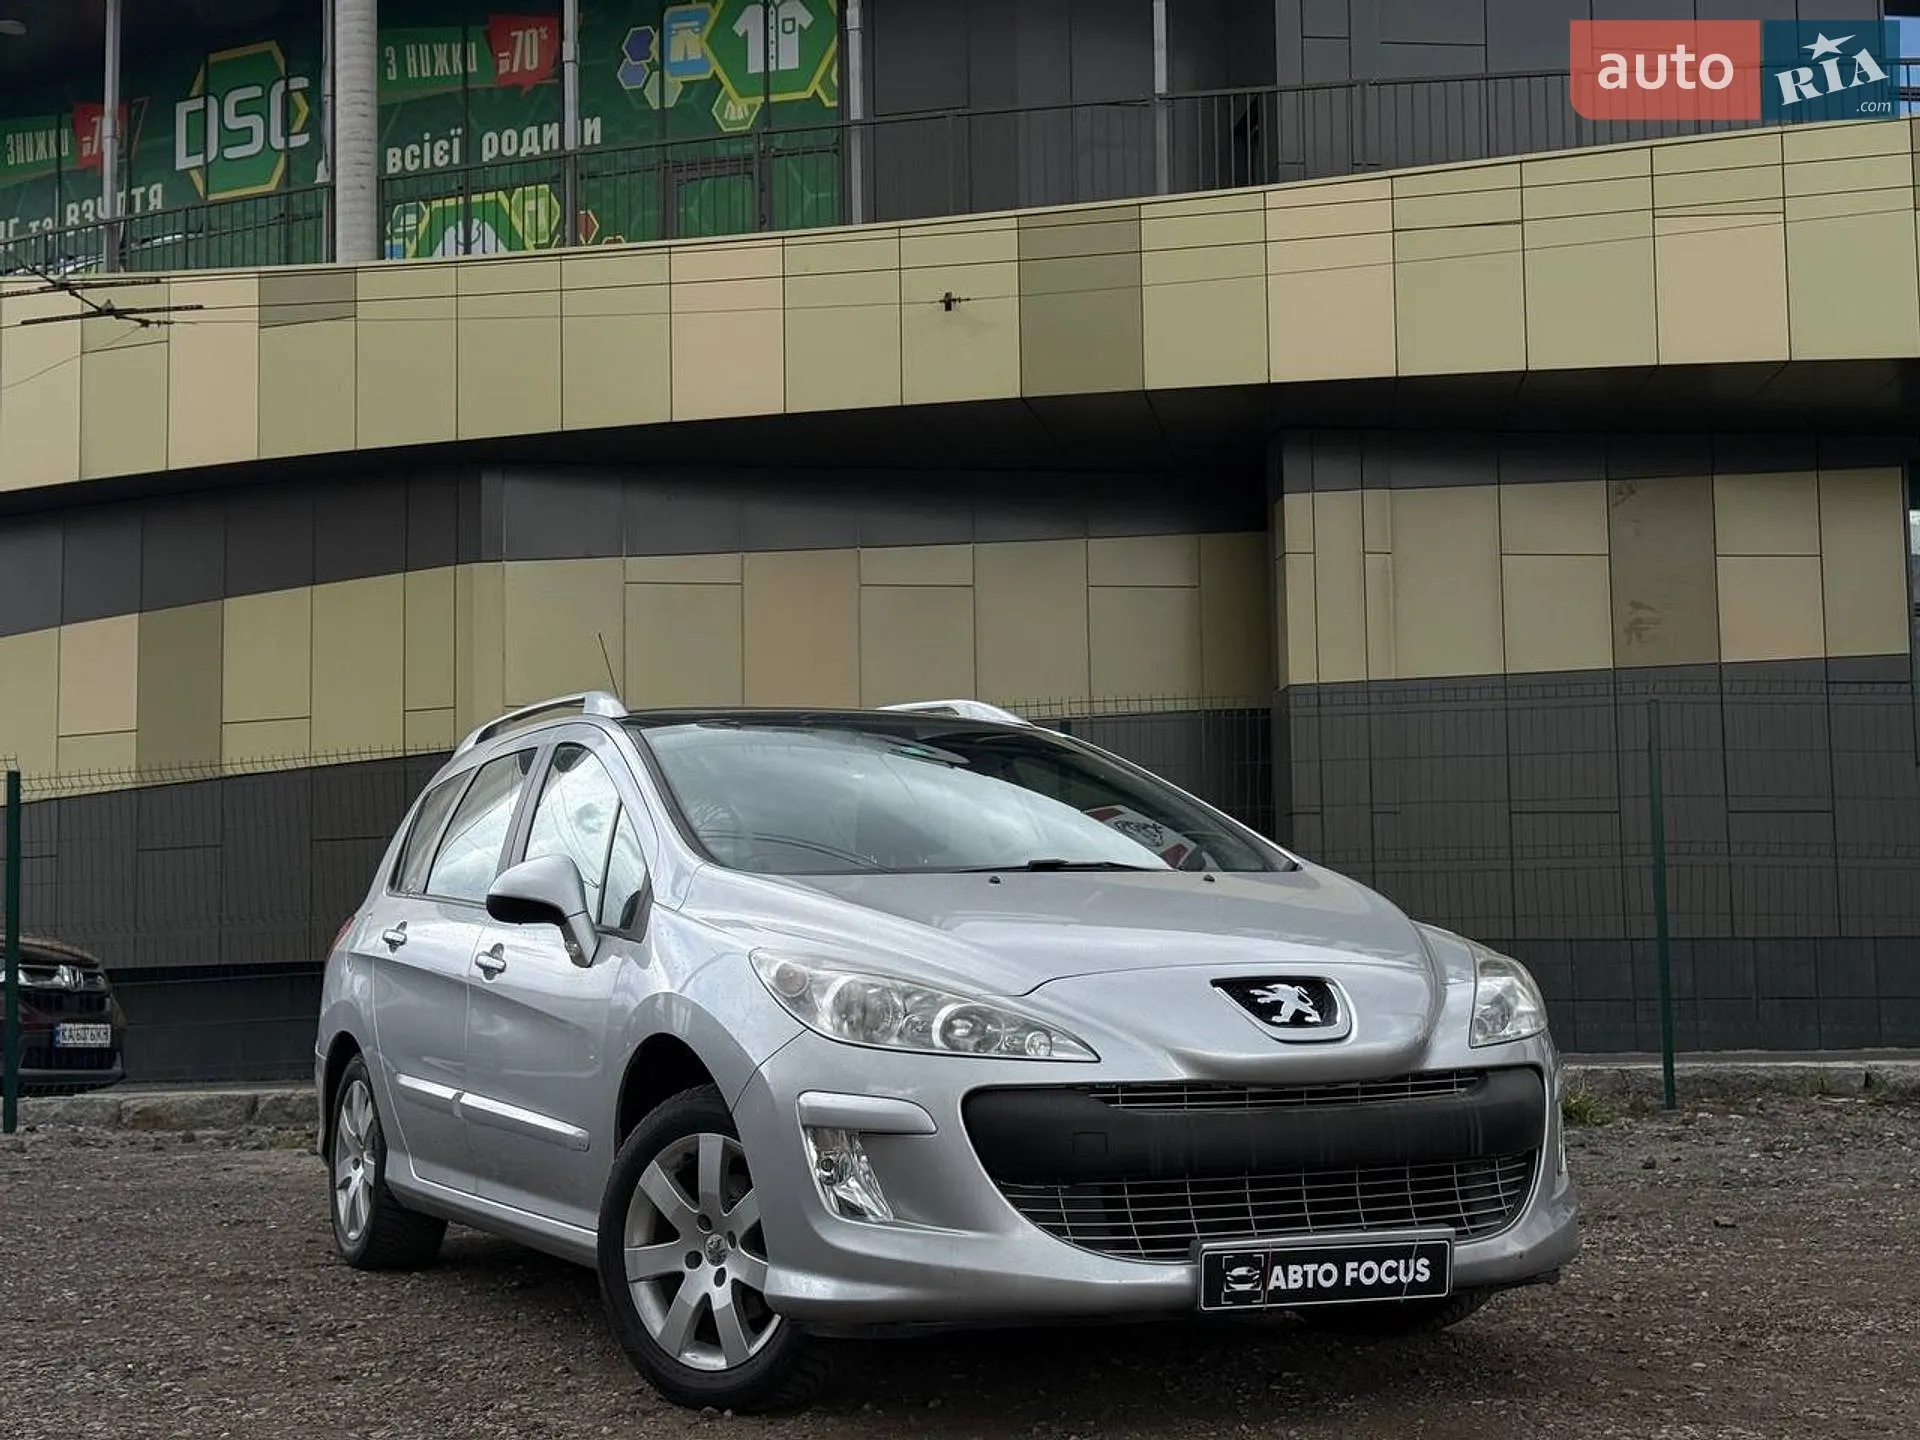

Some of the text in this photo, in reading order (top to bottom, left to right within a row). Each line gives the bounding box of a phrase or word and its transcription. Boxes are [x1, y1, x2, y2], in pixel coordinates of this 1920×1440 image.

[175, 76, 310, 171] DSC
[386, 116, 601, 174] всієї родии
[1267, 1257, 1431, 1290] АВТО FOCUS
